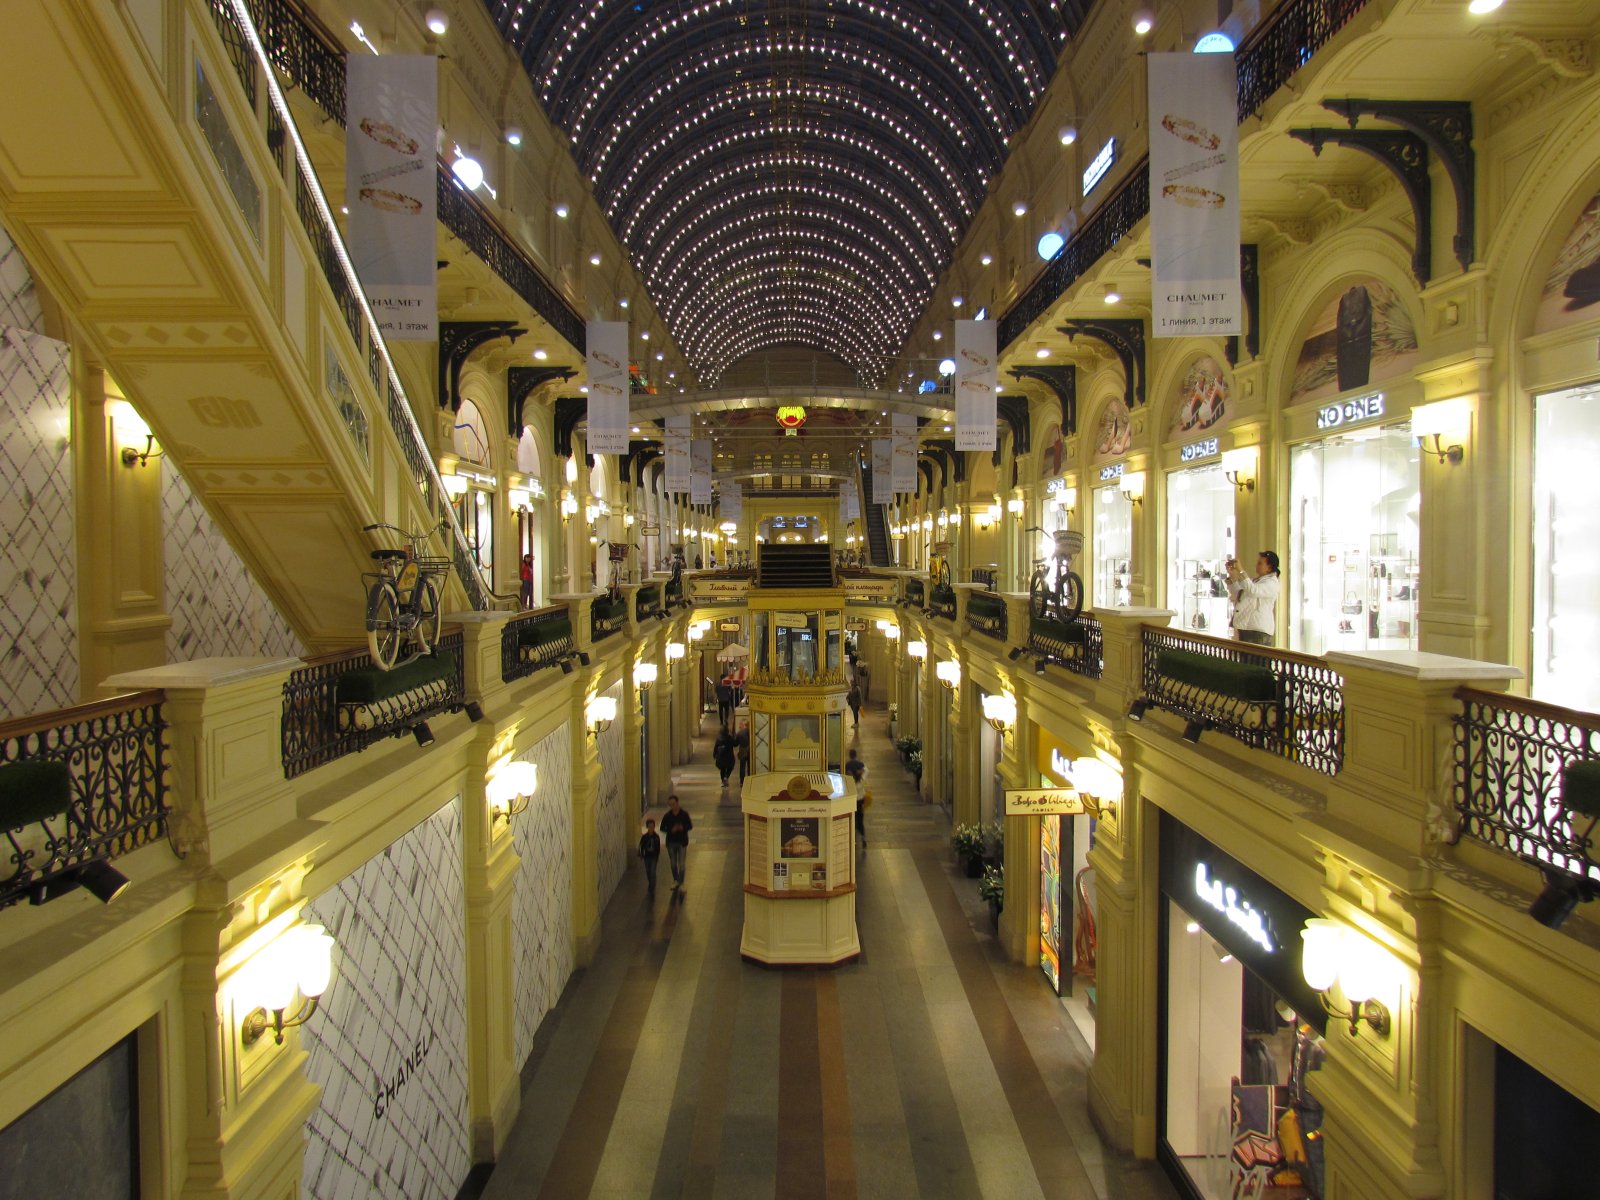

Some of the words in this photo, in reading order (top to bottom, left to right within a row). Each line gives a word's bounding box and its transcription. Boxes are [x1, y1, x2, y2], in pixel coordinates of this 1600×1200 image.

[1166, 293, 1226, 302] CHAUMET
[369, 298, 424, 307] HAUMET
[1162, 318, 1166, 326] 1
[1202, 317, 1206, 325] 1
[1209, 317, 1231, 325] этаж
[398, 322, 403, 330] 1
[406, 323, 428, 331] этаж
[1317, 404, 1343, 429] NO
[1343, 392, 1384, 422] ONE
[1180, 444, 1195, 462] NO
[1195, 438, 1218, 458] ONE
[709, 583, 737, 591] Главный
[375, 1036, 429, 1119] CHANEL
